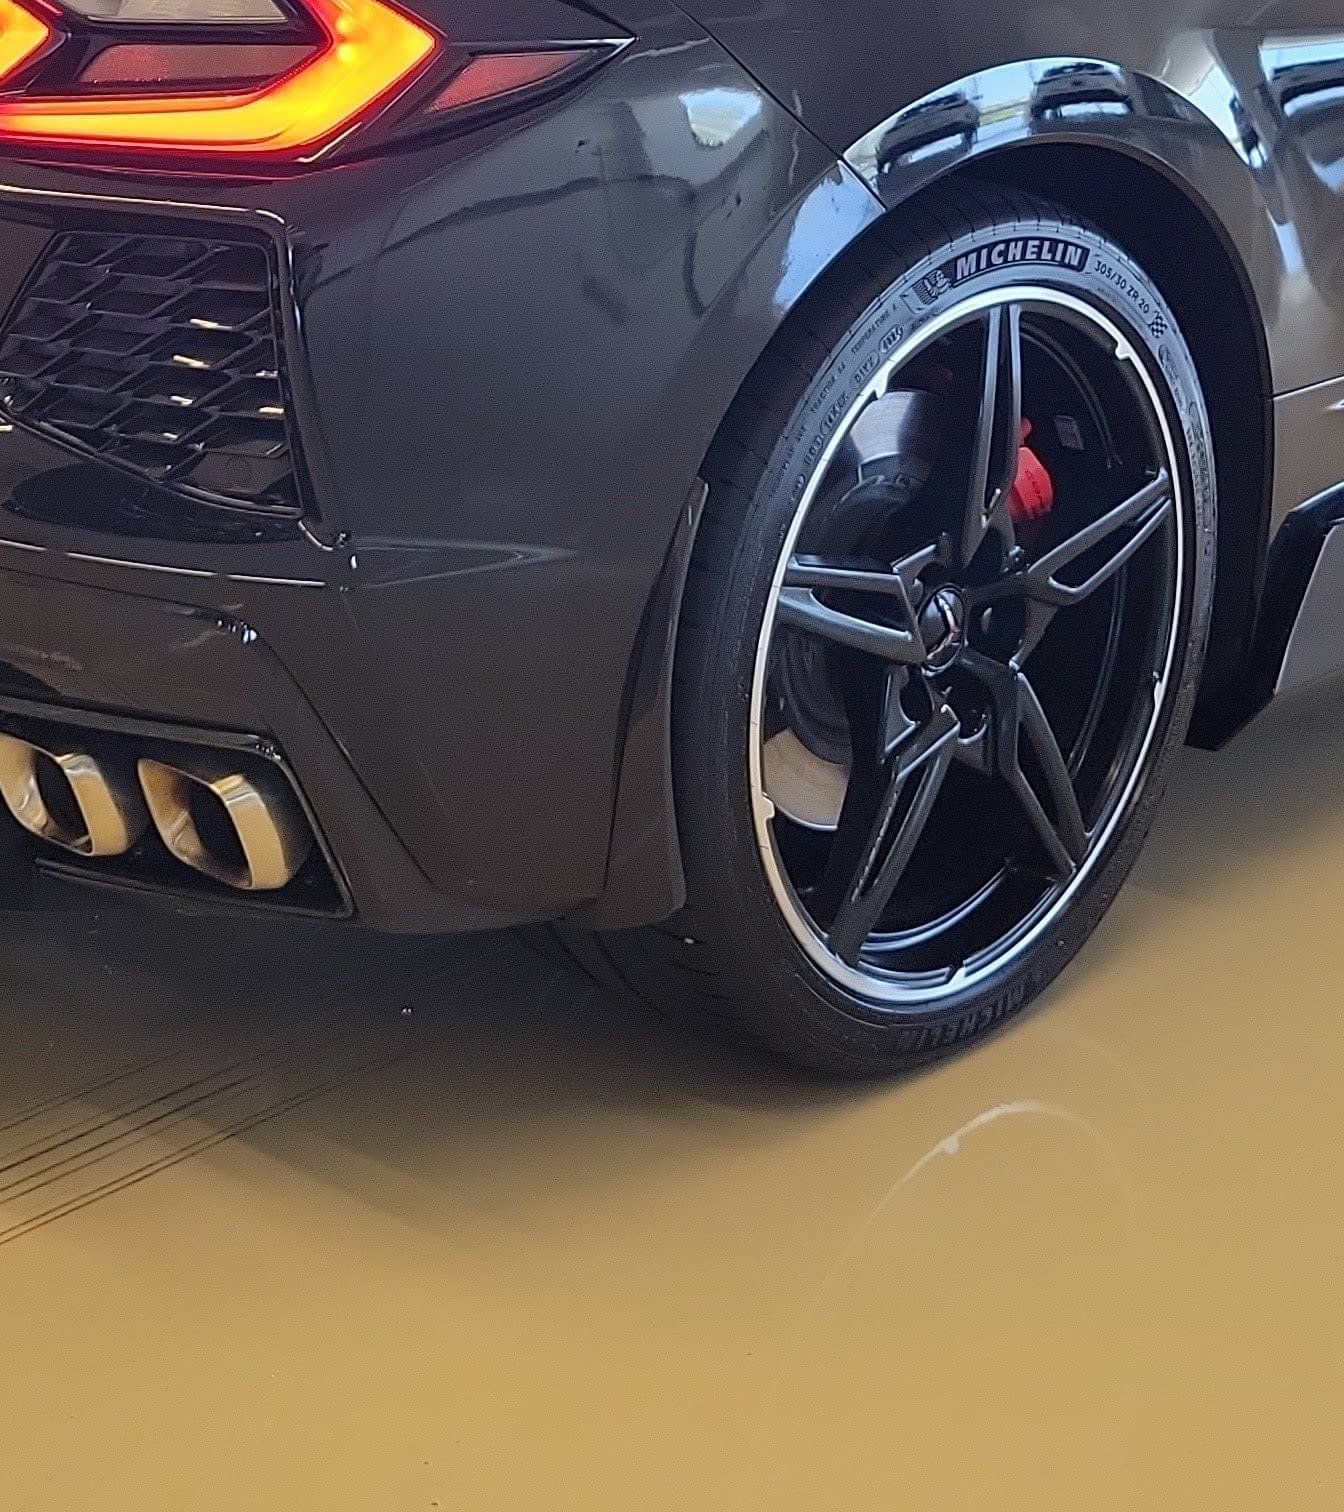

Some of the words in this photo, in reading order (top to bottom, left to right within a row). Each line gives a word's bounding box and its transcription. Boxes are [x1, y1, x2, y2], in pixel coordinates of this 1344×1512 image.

[956, 239, 1085, 279] MICHELIN
[1094, 260, 1127, 290] 305/30
[1126, 285, 1139, 301] ZR
[1138, 297, 1150, 314] 20
